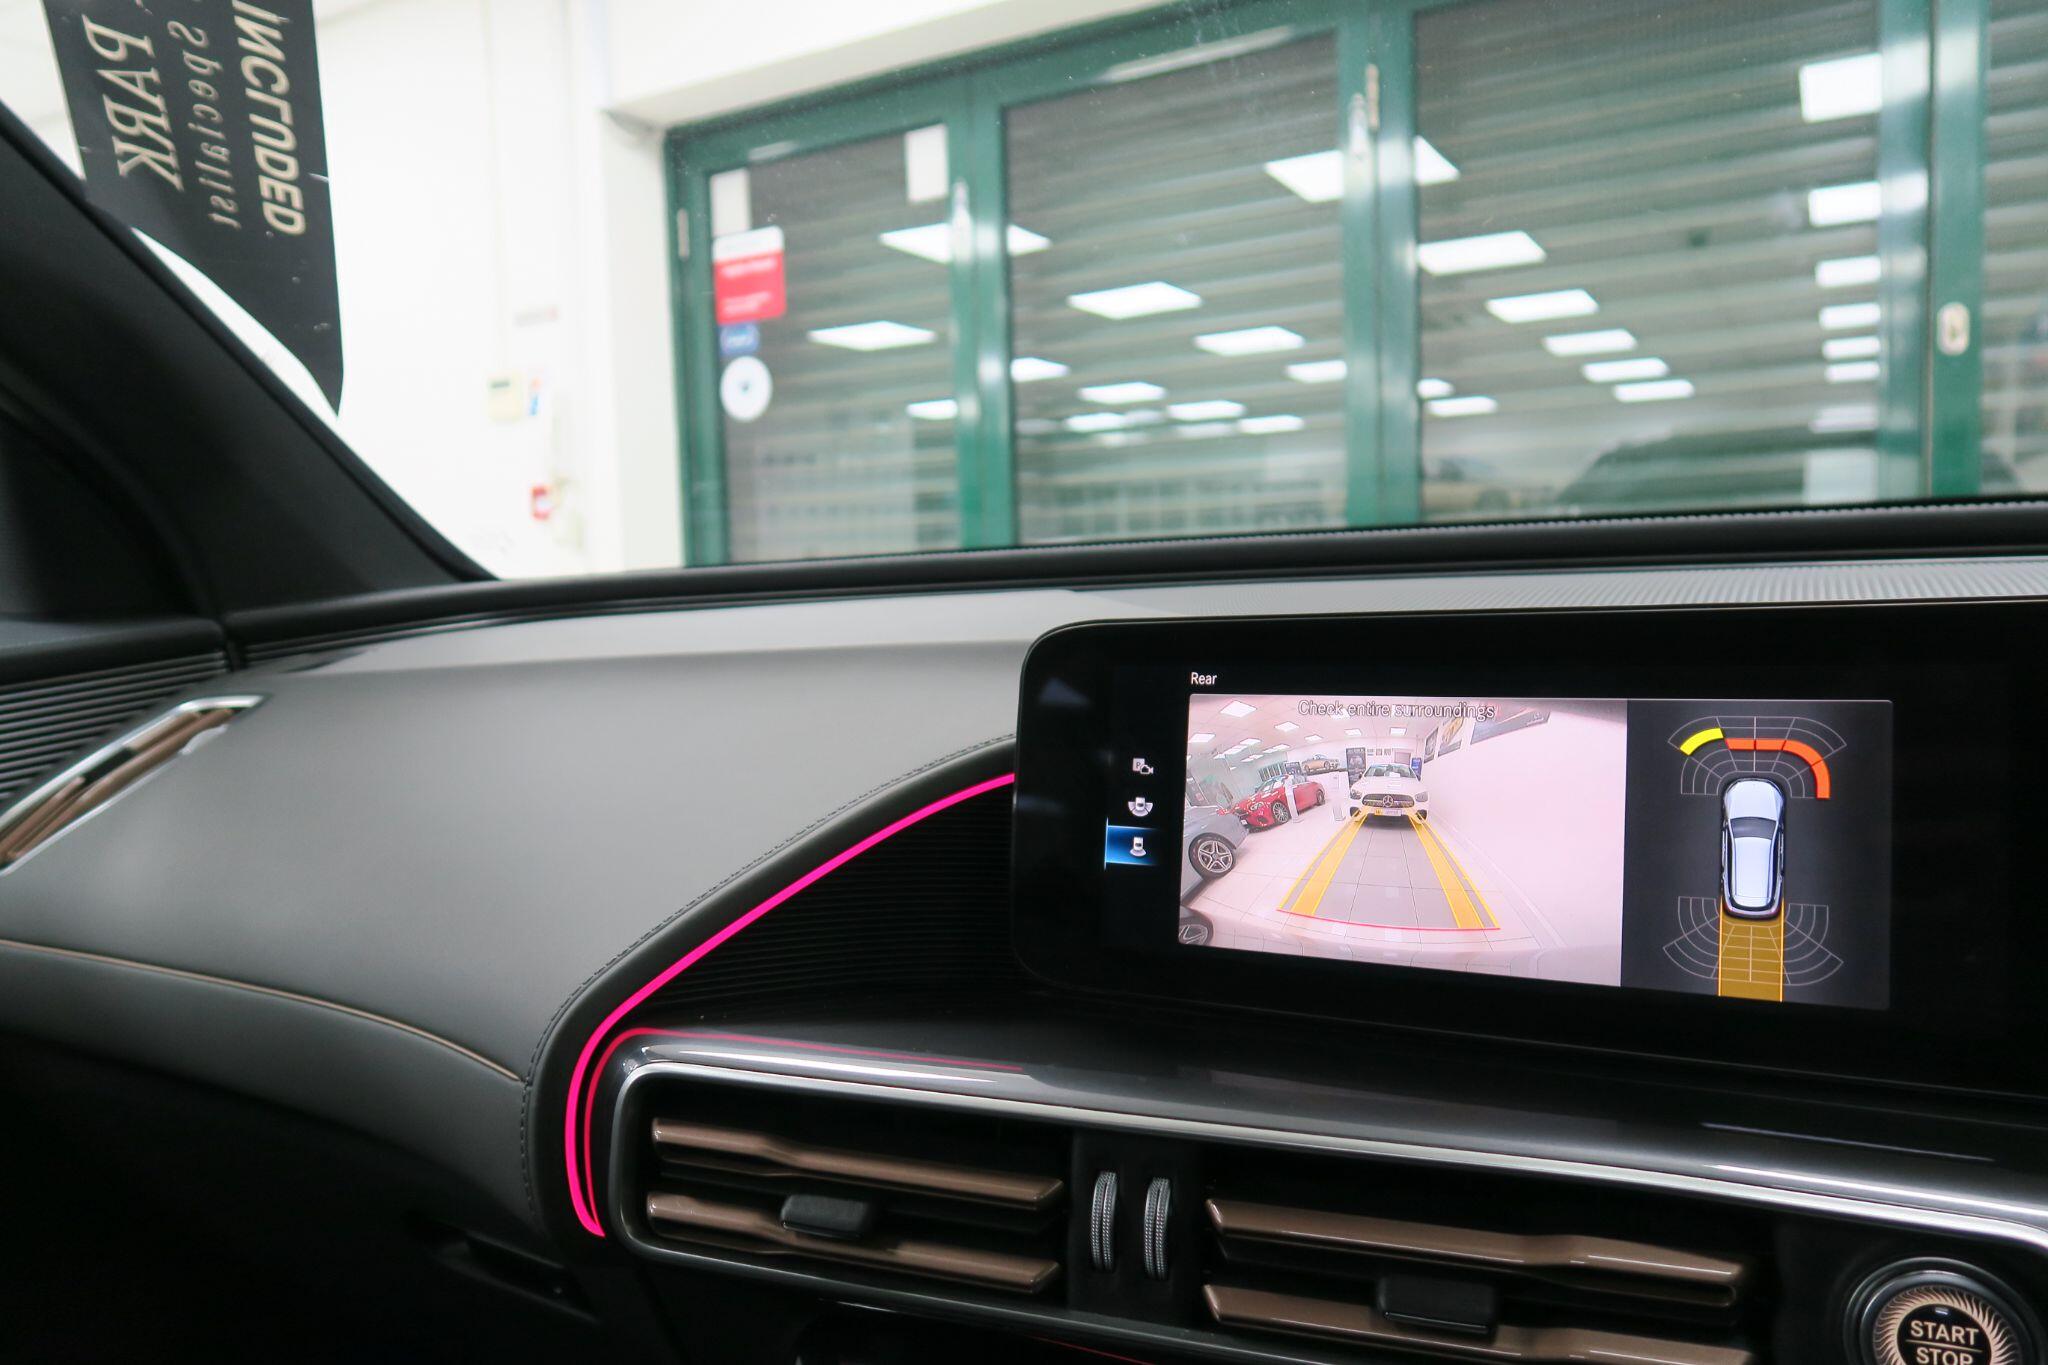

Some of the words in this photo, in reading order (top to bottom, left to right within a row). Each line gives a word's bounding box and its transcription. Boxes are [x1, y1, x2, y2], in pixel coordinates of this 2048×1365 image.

[1190, 671, 1217, 685] Rear
[1298, 700, 1343, 716] Check
[1347, 701, 1390, 717] entire
[1394, 702, 1495, 721] surroundings
[1910, 1320, 1979, 1345] START
[1916, 1347, 1973, 1365] STOP
